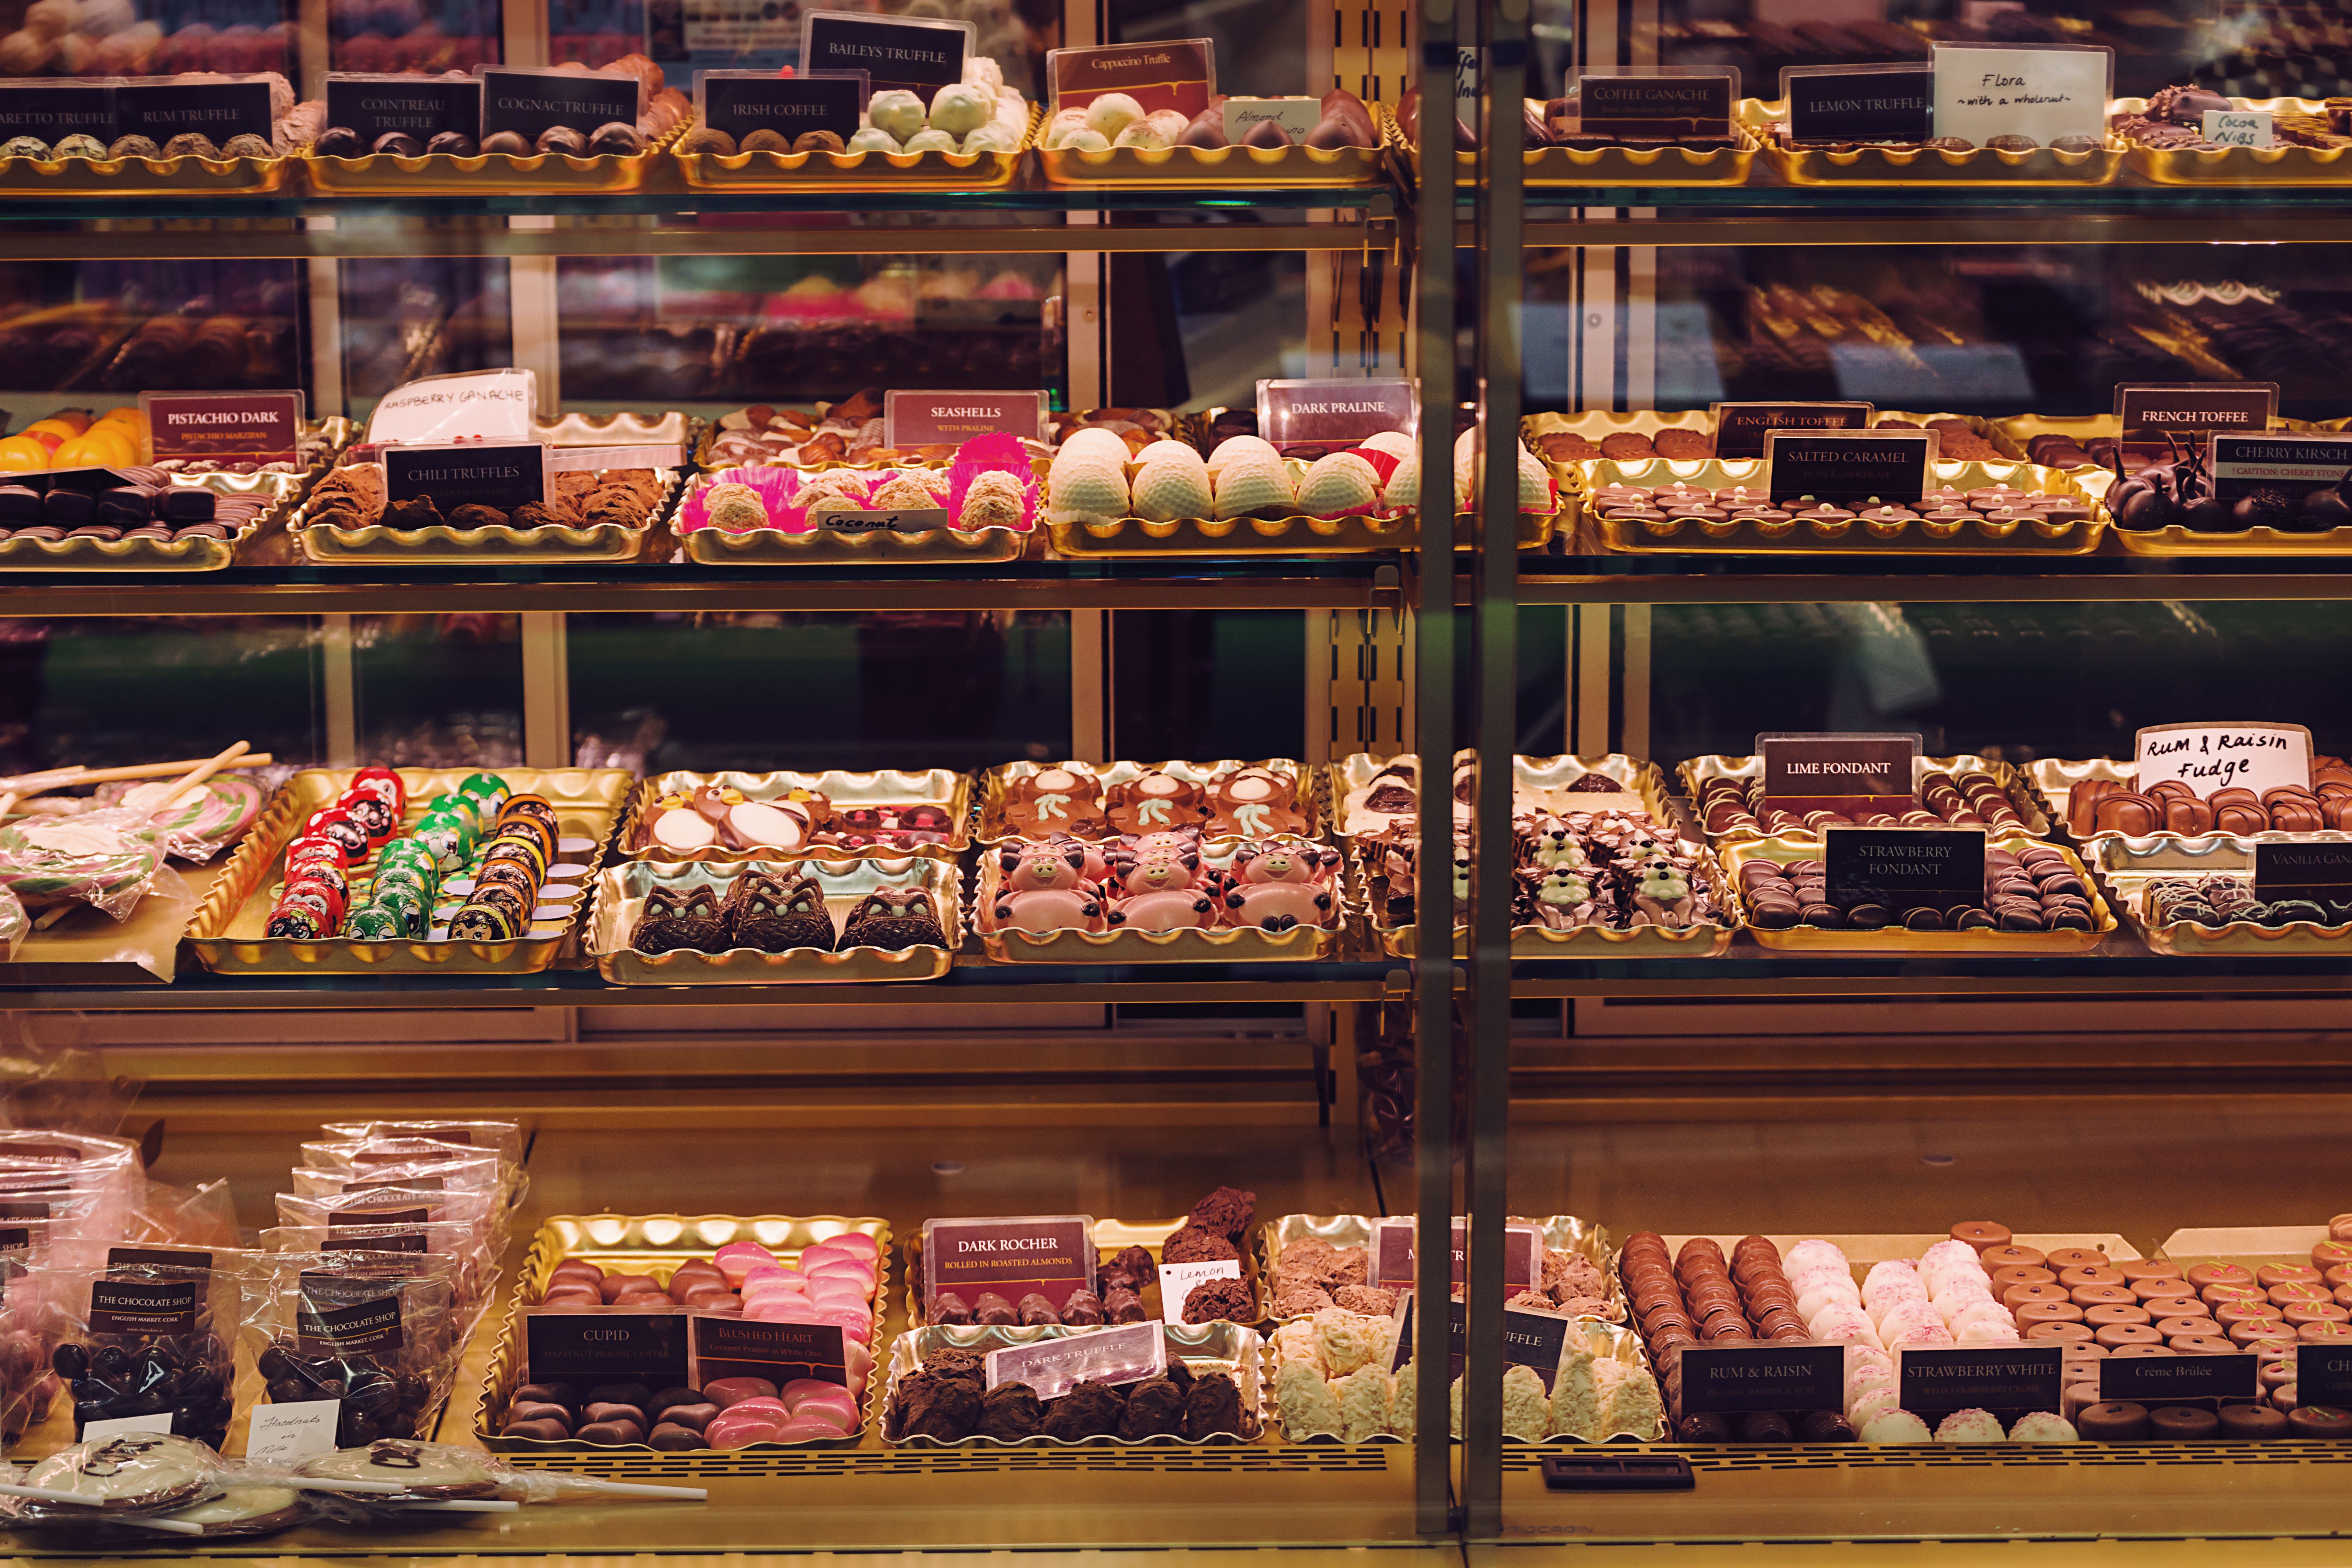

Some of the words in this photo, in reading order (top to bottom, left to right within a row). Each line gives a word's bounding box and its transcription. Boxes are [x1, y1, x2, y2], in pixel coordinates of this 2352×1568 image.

[830, 42, 882, 57] BAILEYS
[885, 47, 946, 63] TRUFFLE
[1091, 57, 1141, 70] Cappuccino
[1142, 54, 1171, 65] Truffle
[1982, 74, 2026, 87] Flora
[1594, 87, 1643, 100] COFFEE
[1644, 89, 1710, 101] GANACHE
[361, 98, 445, 111] COINTREAU
[498, 97, 560, 112] COGNAC
[563, 101, 624, 116] TRUFFLE
[733, 104, 770, 115] IRISH
[774, 104, 828, 116] COFFEE
[1621, 105, 1658, 114] chocolate
[1810, 99, 1862, 113] LEMON
[1863, 97, 1924, 110] TRUFFLE
[56, 113, 116, 124] TRUFFLE
[143, 111, 176, 122] RUM
[179, 109, 240, 121] TRUFFLE
[374, 116, 434, 128] TRUFFLE
[1235, 110, 1284, 123] Almond
[384, 392, 454, 411] RASPBERRY
[458, 389, 524, 403] GANACHE
[931, 407, 1002, 418] SEASHELLS
[1292, 403, 1329, 414] DARK
[1330, 401, 1386, 413] PRALINE
[168, 412, 239, 425] PISTACHIO
[241, 411, 280, 424] DARK
[1737, 416, 1796, 426] ENGLISH
[1799, 417, 1848, 427] TOFFEE
[2142, 411, 2196, 422] FRENCH
[2198, 411, 2249, 422] TOFFEE
[1788, 451, 1840, 463] SALTED
[1842, 452, 1909, 463] CARAMEL
[2235, 446, 2292, 459] CHERRY
[2296, 448, 2347, 460] KIRSCH
[408, 468, 448, 482] CHILI
[450, 466, 520, 479] TRUFFLES
[2236, 467, 2279, 476] CAUTION:
[825, 514, 900, 528] Coconut
[2199, 735, 2209, 755] &
[2217, 733, 2287, 751] Raisin
[1786, 762, 1819, 775] LIME
[1823, 762, 1892, 775] FONDANT
[2177, 758, 2250, 787] Fudge
[1859, 845, 1952, 858] STRAWBERRY
[2272, 854, 2323, 865] VANILLA
[2324, 853, 2352, 865] GAN
[1869, 863, 1942, 875] FONDANT
[958, 1239, 996, 1253] DARK
[999, 1237, 1059, 1251] ROCHER
[945, 1259, 978, 1269] ROLLED
[979, 1259, 989, 1268] IN
[991, 1258, 1029, 1268] ROASTED
[1030, 1257, 1073, 1267] ALMONDS
[1181, 1267, 1224, 1280] Lemon
[324, 1287, 376, 1298] CHOCOLATE
[98, 1295, 115, 1304] THE
[118, 1297, 170, 1307] CHOCOLATE
[172, 1296, 191, 1306] SHOP
[304, 1324, 321, 1332] THE
[323, 1318, 373, 1333] CHOCOLATE
[375, 1311, 395, 1323] SHOP
[583, 1330, 629, 1341] CUPID
[709, 1343, 741, 1352] Caramel
[743, 1346, 770, 1354] Praline
[1021, 1352, 1062, 1368] DARK
[1064, 1342, 1127, 1361] TRUFFLE
[1710, 1367, 1743, 1379] RUM
[1748, 1366, 1760, 1378] &
[1764, 1364, 1813, 1377] RAISIN
[1907, 1364, 2005, 1378] STRAWBERRY
[2006, 1363, 2057, 1376] WHITE
[2135, 1365, 2172, 1377] Crème
[2175, 1365, 2212, 1377] Brûlée
[2327, 1360, 2352, 1372] CH
[260, 1414, 321, 1431] Hazelnuts
[280, 1431, 297, 1440] in
